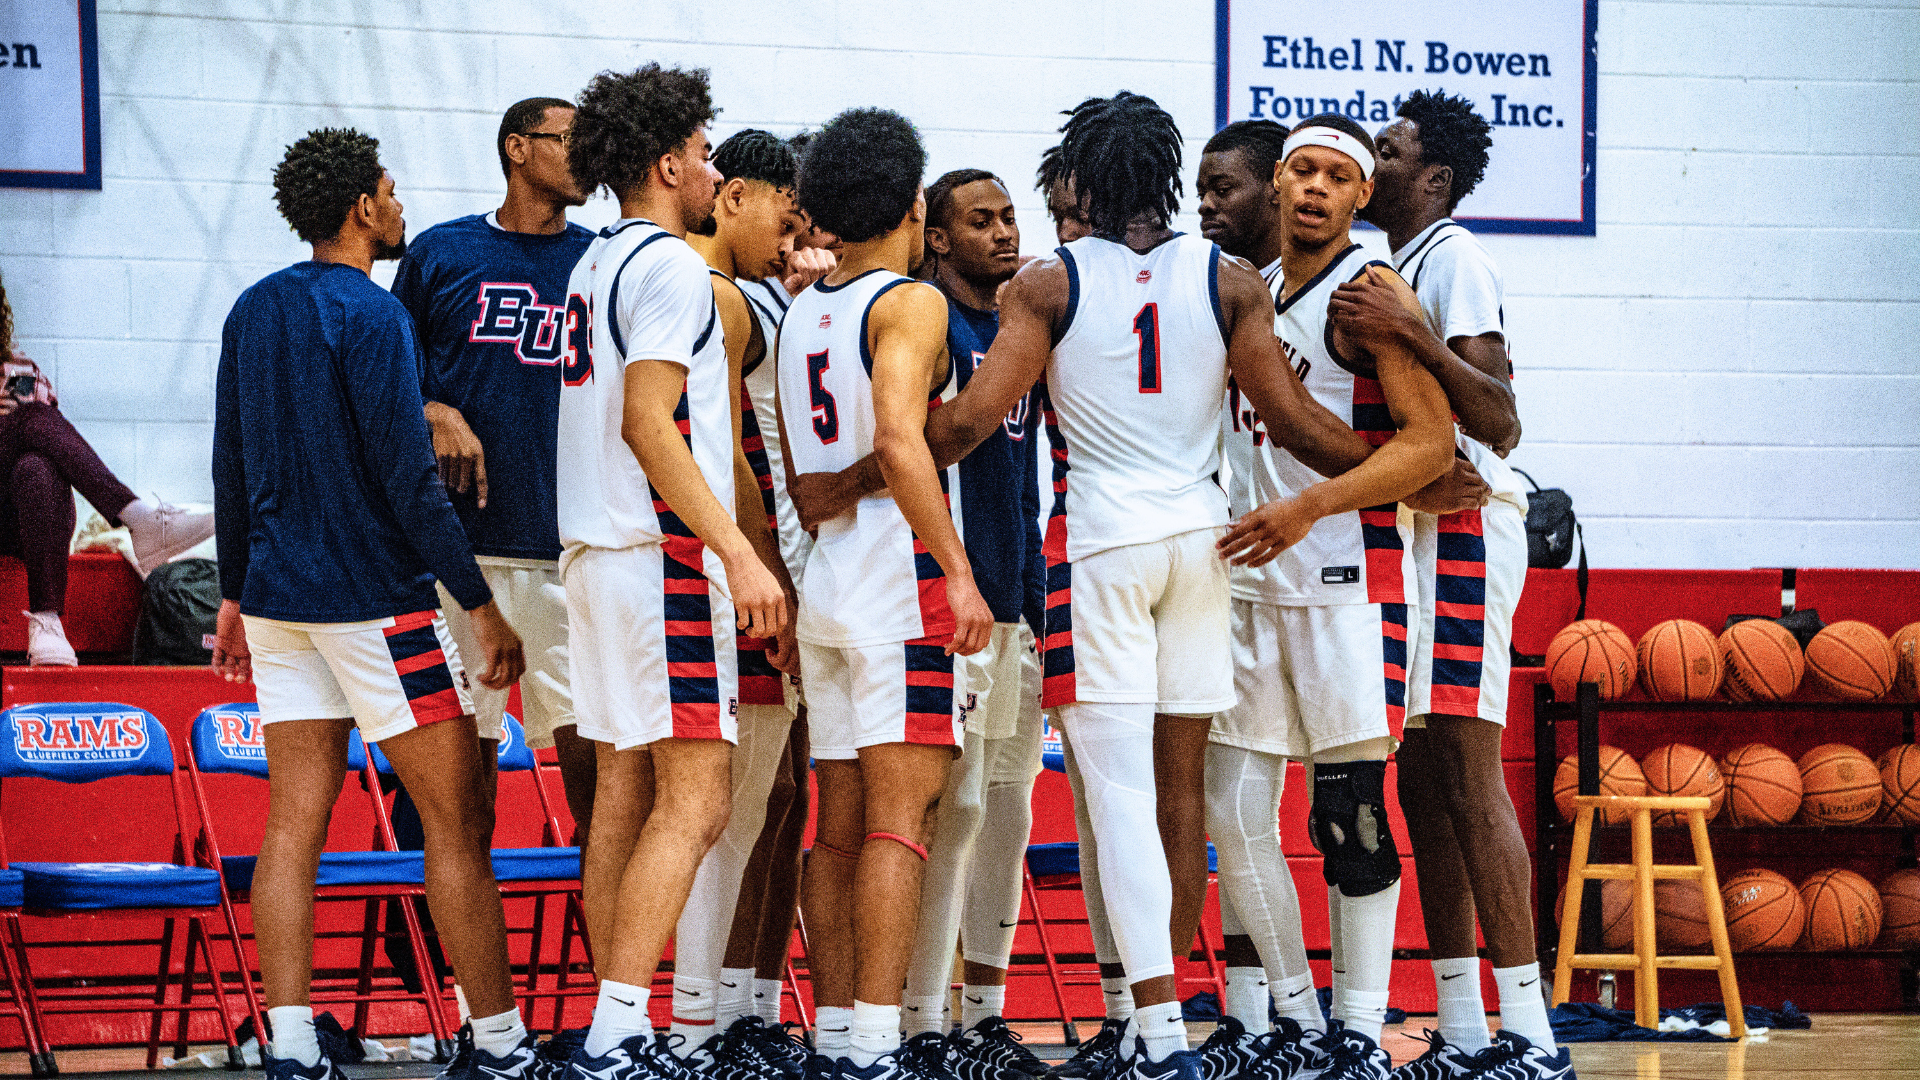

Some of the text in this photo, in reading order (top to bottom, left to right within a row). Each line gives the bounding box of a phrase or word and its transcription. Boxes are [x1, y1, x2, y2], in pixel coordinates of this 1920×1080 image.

[1263, 35, 1551, 76] Ethel N. Bowen
[1249, 86, 1563, 128] Founda Inc.
[469, 282, 565, 366] BU
[1133, 302, 1162, 393] 1
[806, 348, 839, 445] 5
[14, 716, 146, 750] RAMS
[214, 714, 265, 748] RA
[26, 750, 132, 760] BLUEFIELD COLLEGE
